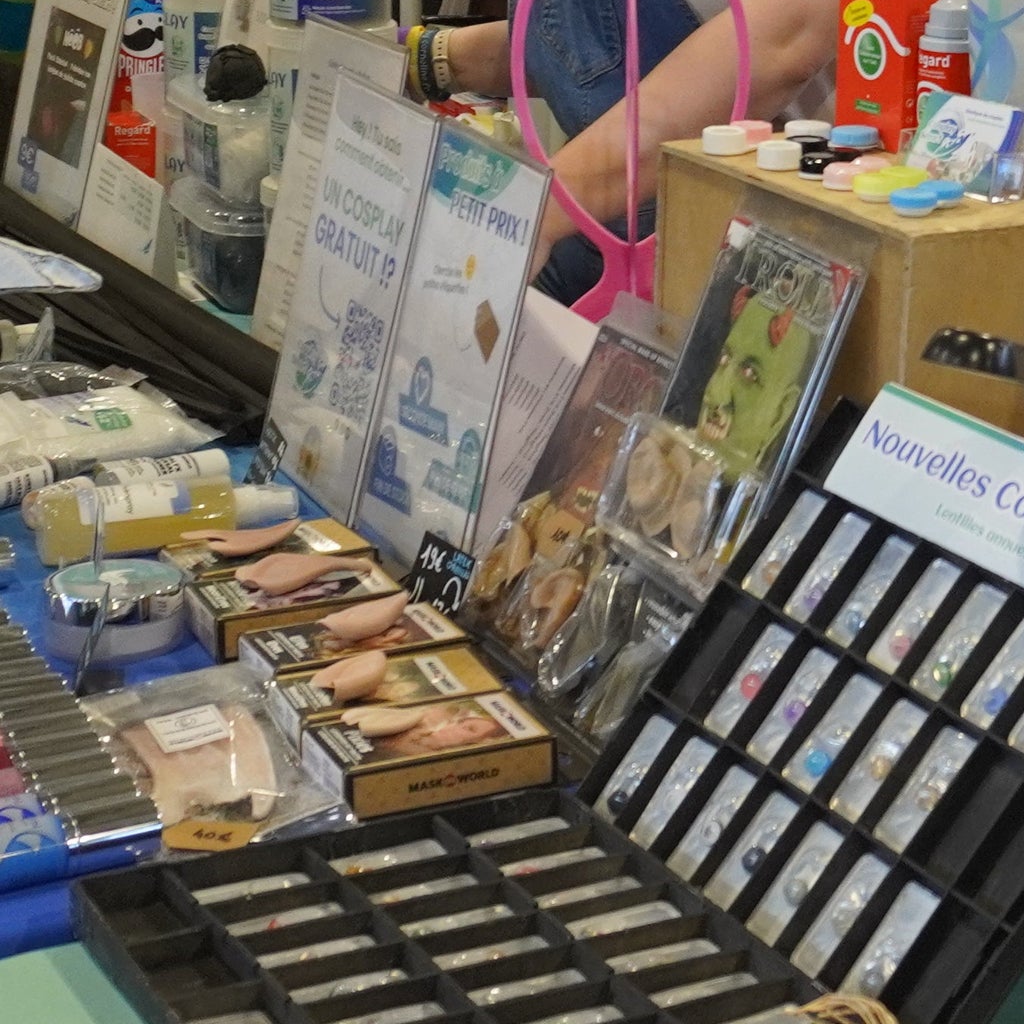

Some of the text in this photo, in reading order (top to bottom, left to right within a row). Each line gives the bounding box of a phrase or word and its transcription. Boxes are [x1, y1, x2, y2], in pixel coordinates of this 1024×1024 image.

[164, 14, 188, 29] LAY
[118, 53, 165, 78] PRINGLE
[918, 55, 951, 68] egard
[114, 125, 151, 136] Regard
[165, 157, 185, 172] LAY
[323, 176, 404, 247] UN COSPLAY
[449, 191, 487, 226] PETIT
[487, 206, 521, 243] PRIX
[315, 213, 379, 278] GRATUIT
[862, 419, 992, 499] Nouvelles
[934, 503, 985, 538] Lentilles
